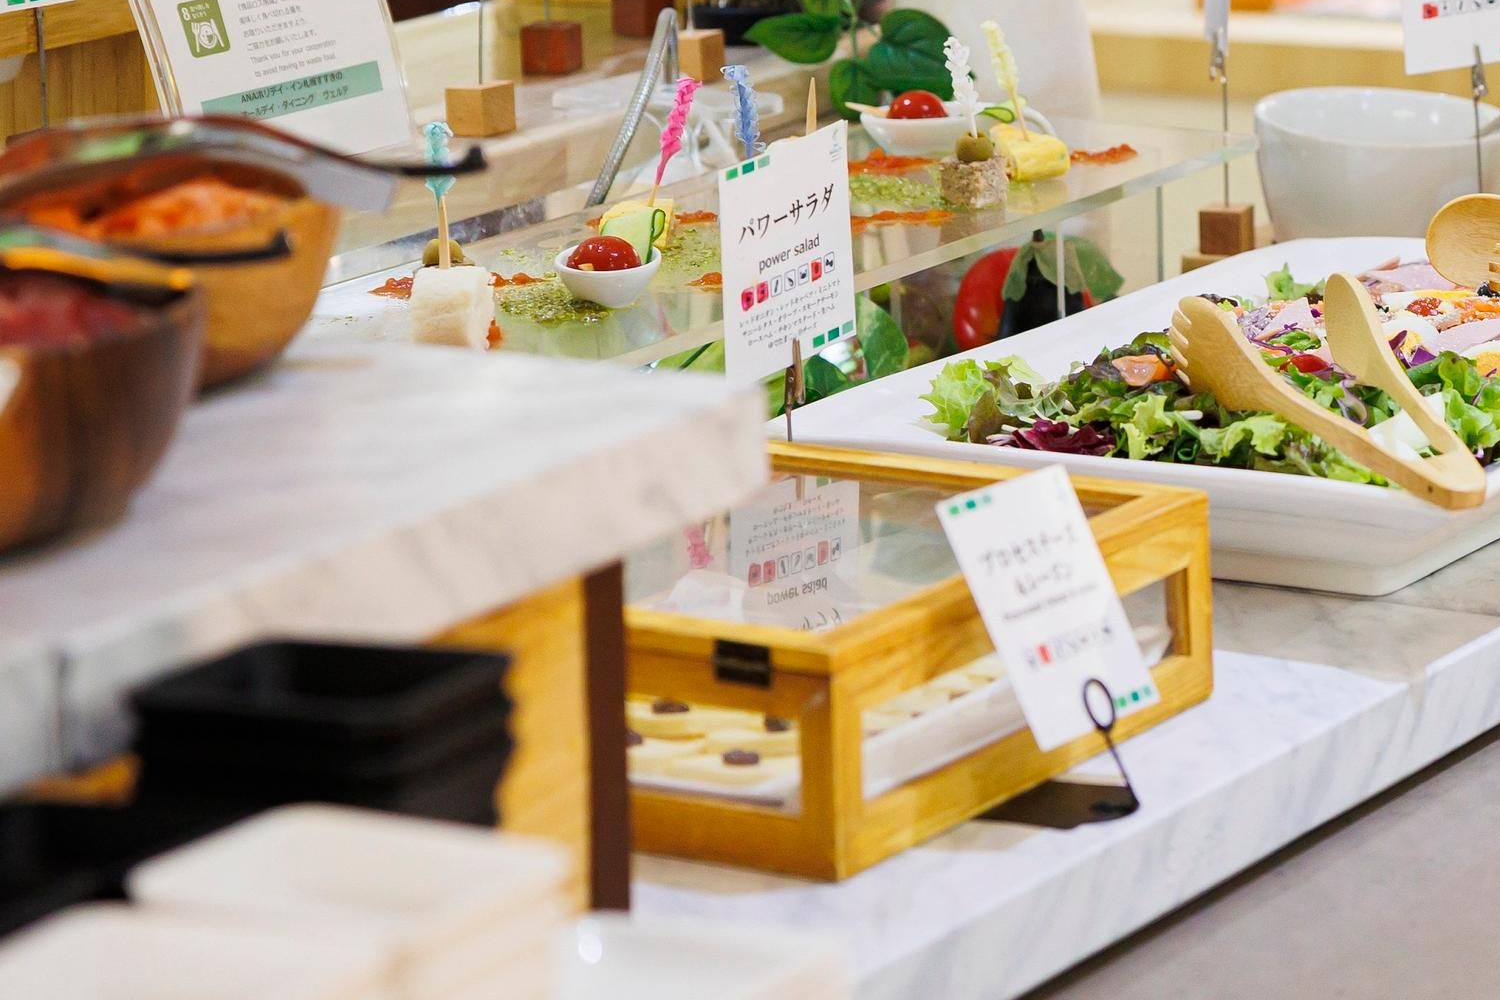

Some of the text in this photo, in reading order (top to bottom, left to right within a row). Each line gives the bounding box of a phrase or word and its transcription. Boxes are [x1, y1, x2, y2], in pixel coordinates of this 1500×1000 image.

[180, 7, 190, 21] 8
[739, 183, 834, 245] パワーサラダ
[759, 233, 820, 274] power salad
